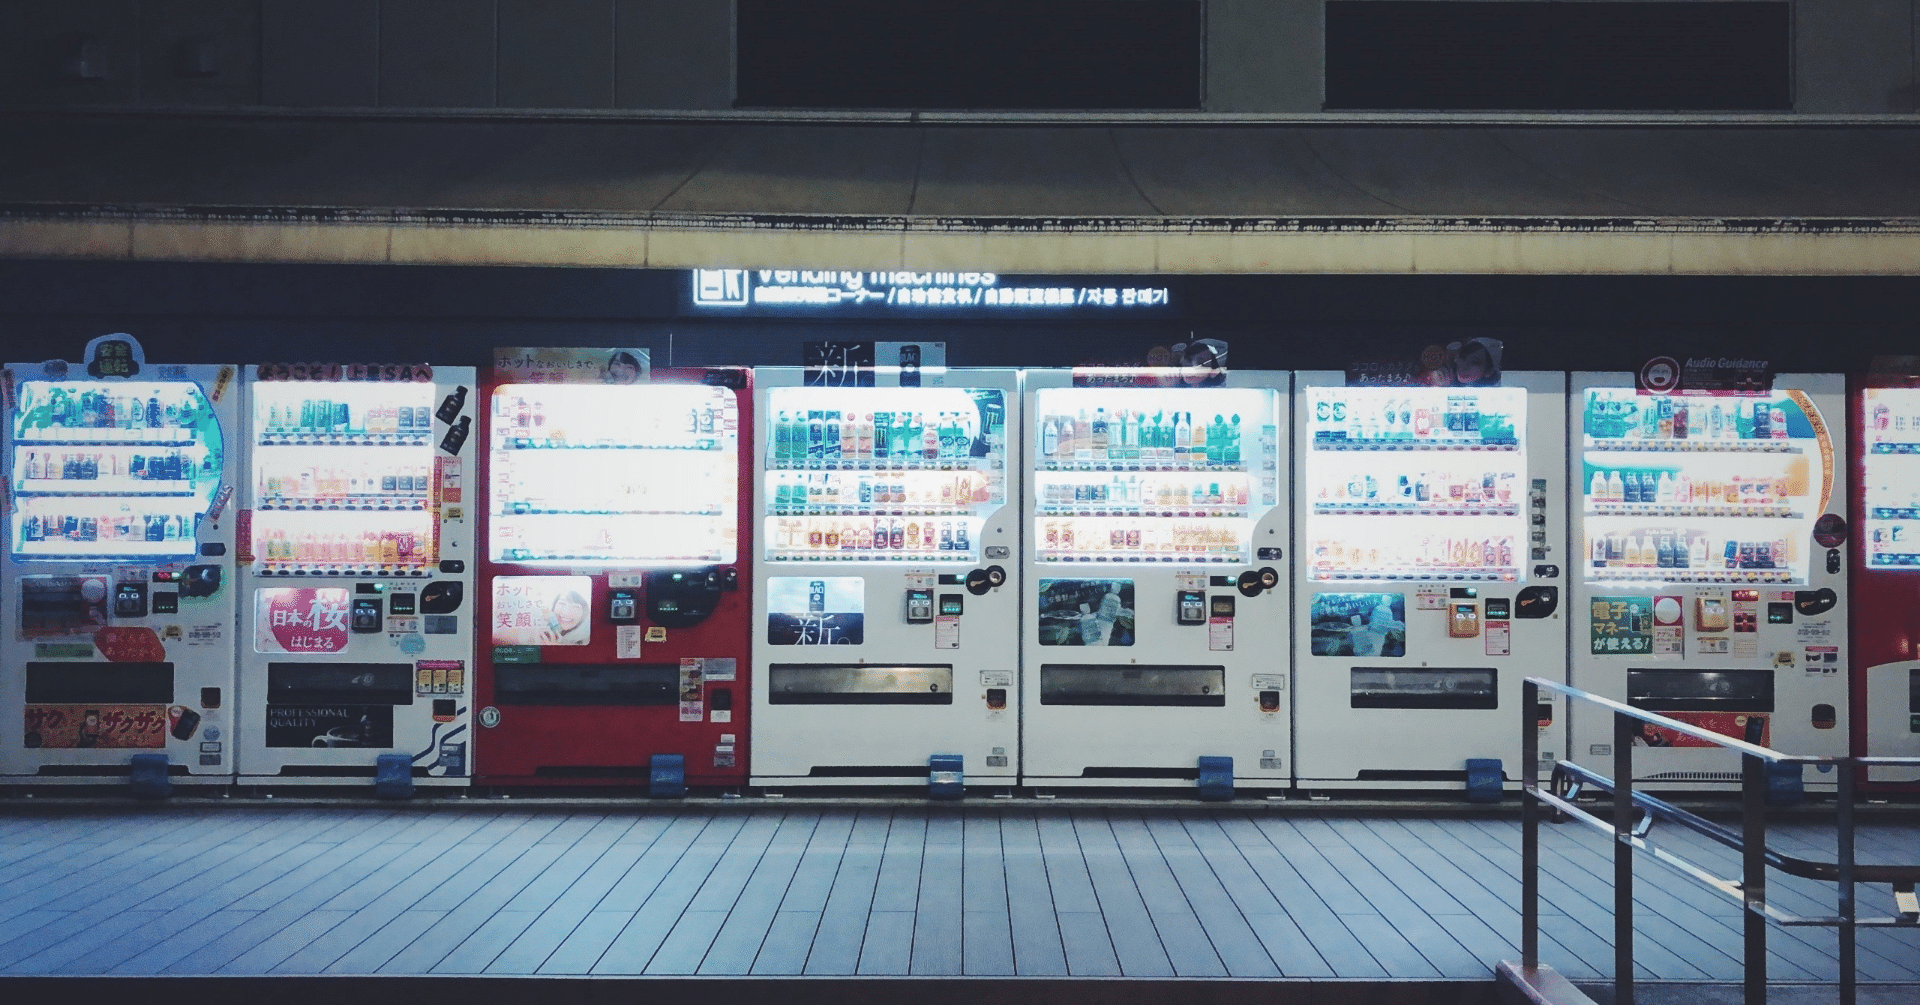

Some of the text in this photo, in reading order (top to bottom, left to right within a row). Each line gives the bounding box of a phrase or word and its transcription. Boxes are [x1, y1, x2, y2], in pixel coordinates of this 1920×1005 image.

[1685, 357, 1769, 369] Audio Guidance
[1592, 601, 1629, 620] 電子
[1592, 621, 1629, 635] マネー
[290, 636, 334, 649] はじまる
[270, 708, 349, 718] PROFESSIONAL
[270, 718, 317, 728] QUALITY
